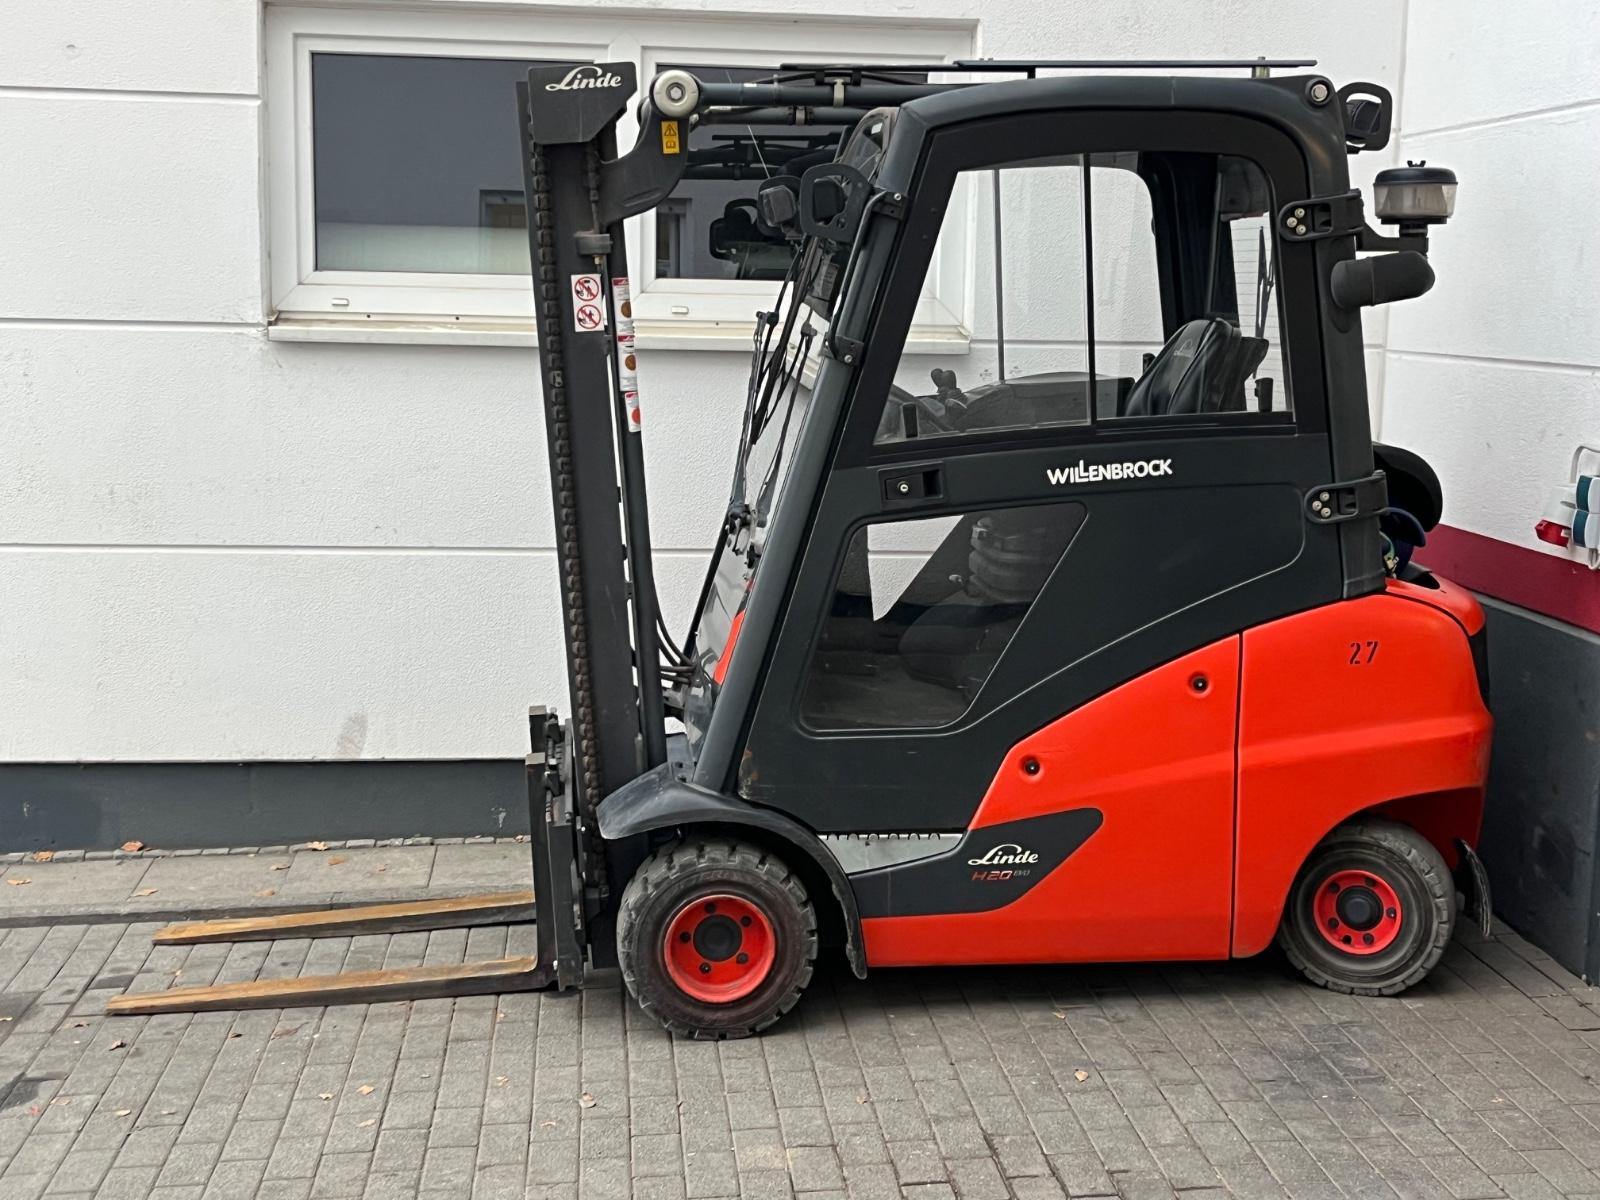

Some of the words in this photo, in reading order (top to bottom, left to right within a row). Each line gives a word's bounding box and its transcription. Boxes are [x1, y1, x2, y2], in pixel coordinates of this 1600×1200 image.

[545, 65, 622, 91] Linde
[1046, 459, 1173, 485] WILLENBROCK
[1350, 641, 1379, 665] 27
[967, 843, 1039, 866] Linde
[971, 870, 1013, 881] H20
